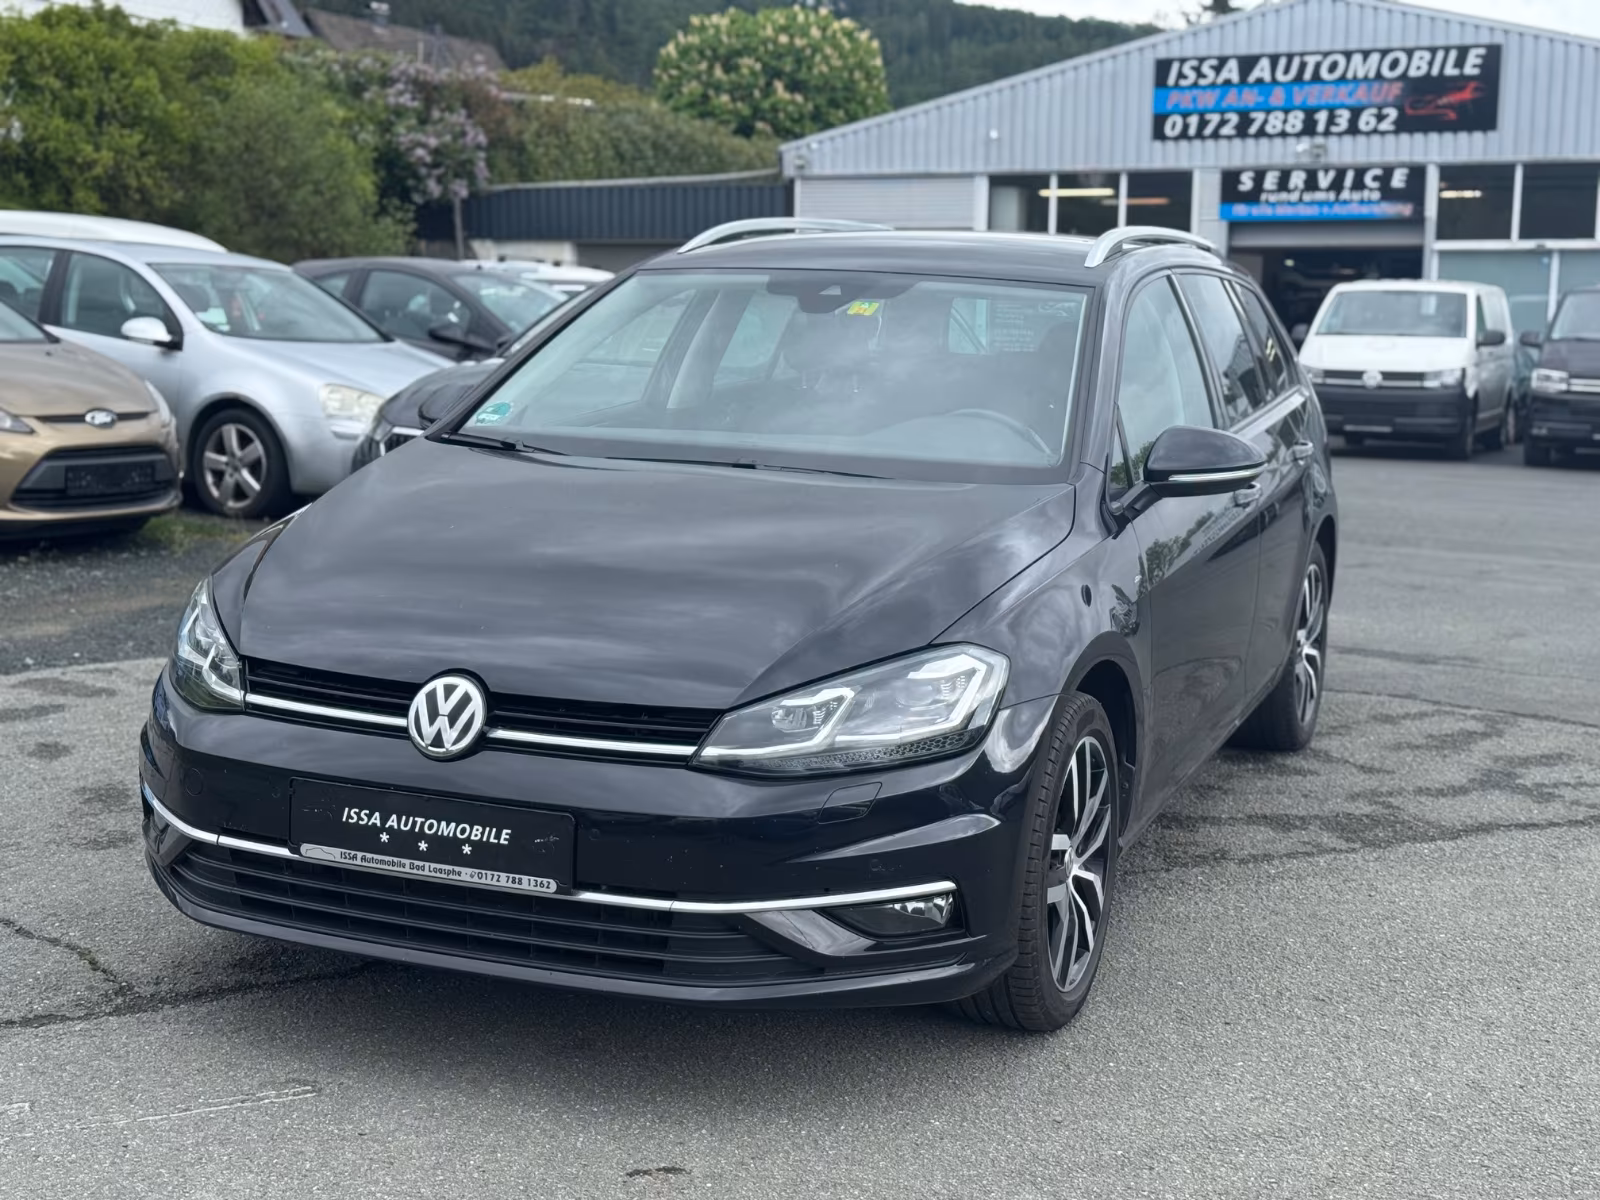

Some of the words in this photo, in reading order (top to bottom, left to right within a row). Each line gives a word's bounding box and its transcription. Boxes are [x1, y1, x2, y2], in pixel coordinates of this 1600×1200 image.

[1166, 57, 1239, 87] ISSA
[1246, 47, 1487, 82] AUTOMOBILE
[1164, 113, 1239, 137] 0172
[1248, 110, 1304, 134] 788
[1312, 108, 1350, 133] 13
[1357, 106, 1398, 131] 62
[1237, 168, 1410, 191] SERVICE
[342, 807, 381, 826] ISSA
[385, 813, 511, 845] AUTOMOBILE
[340, 851, 358, 862] ISSA
[360, 855, 406, 869] Automobile
[409, 862, 426, 872] Bad
[428, 864, 462, 877] Laasphe
[476, 871, 502, 883] 0172
[505, 875, 523, 886] 788
[527, 878, 551, 889] 1362
